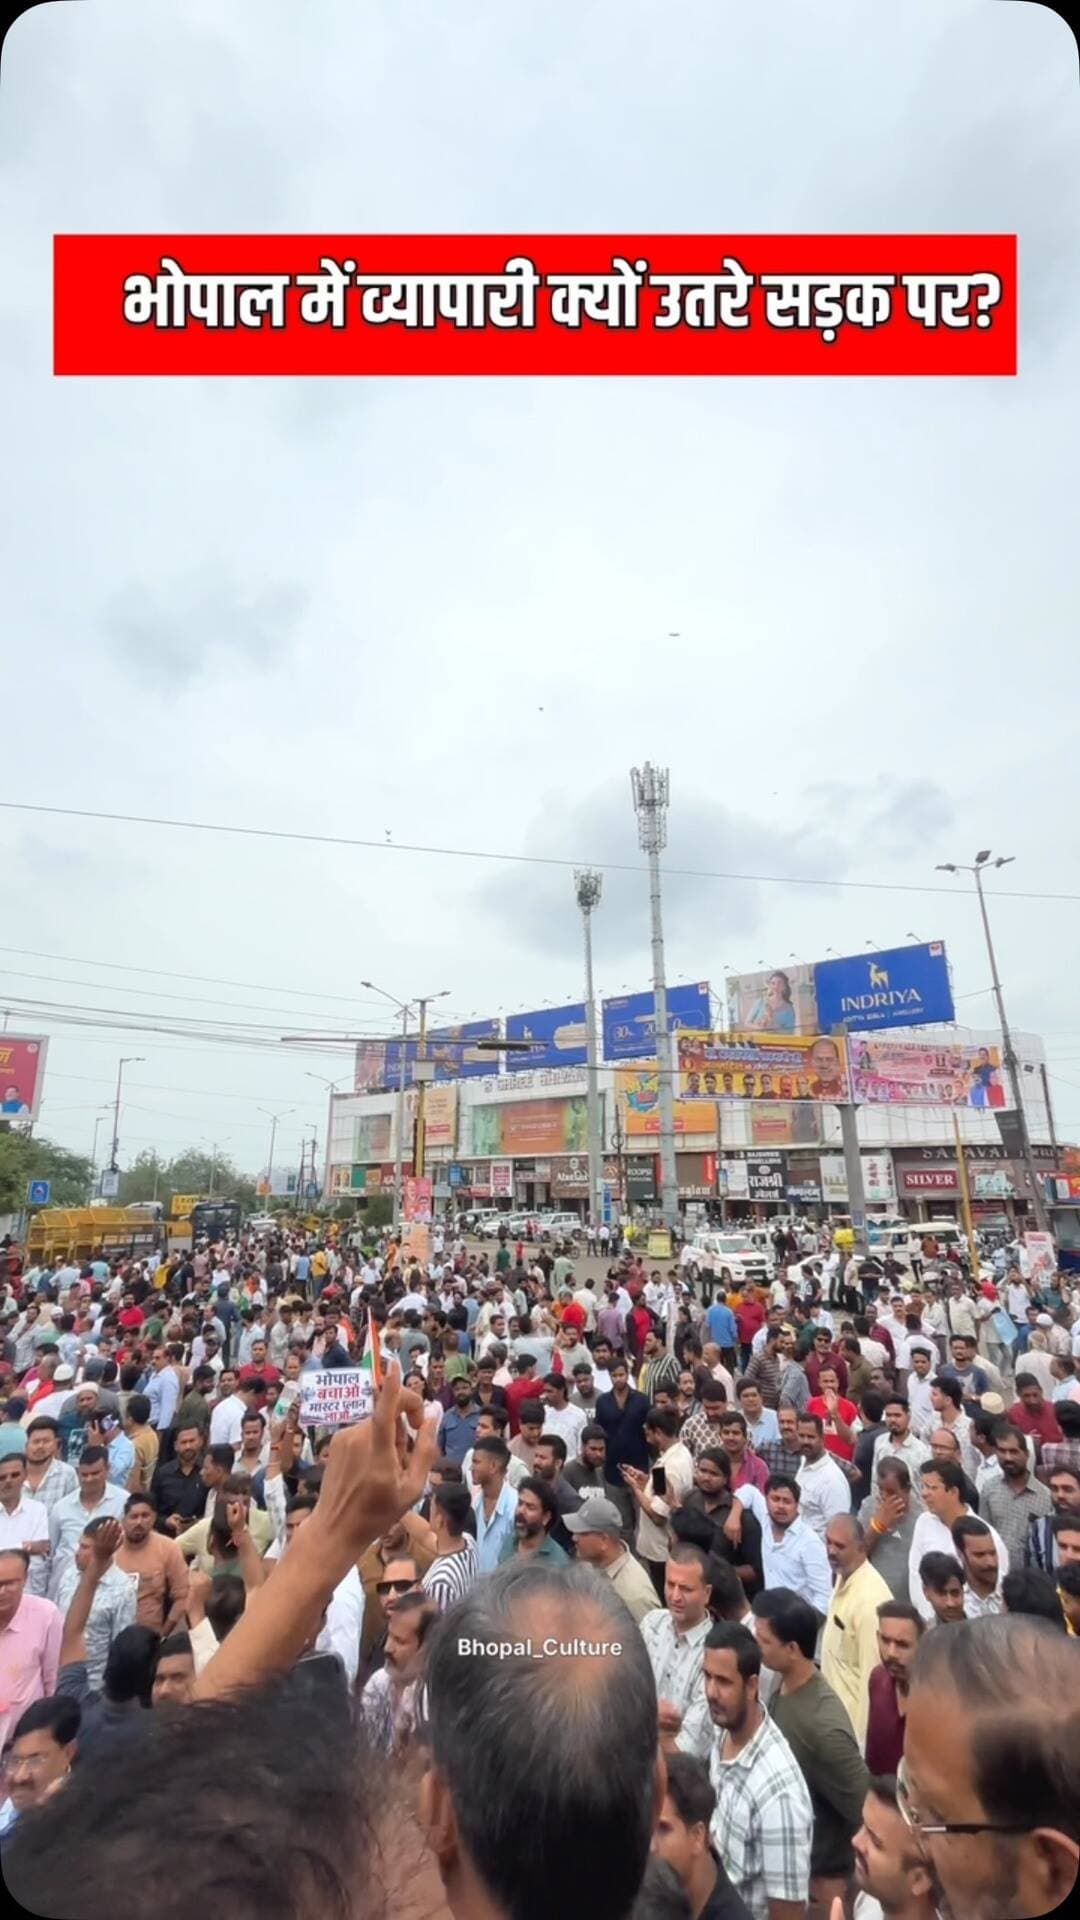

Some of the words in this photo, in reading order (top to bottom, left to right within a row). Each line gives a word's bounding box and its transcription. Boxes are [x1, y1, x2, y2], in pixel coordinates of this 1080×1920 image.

[841, 988, 922, 1012] INDRIYA
[905, 1174, 955, 1186] SILVER
[315, 1372, 360, 1386] भोपाल
[317, 1384, 360, 1399] बचाओ
[309, 1401, 340, 1412] मास्टर
[342, 1400, 366, 1410] प्लान
